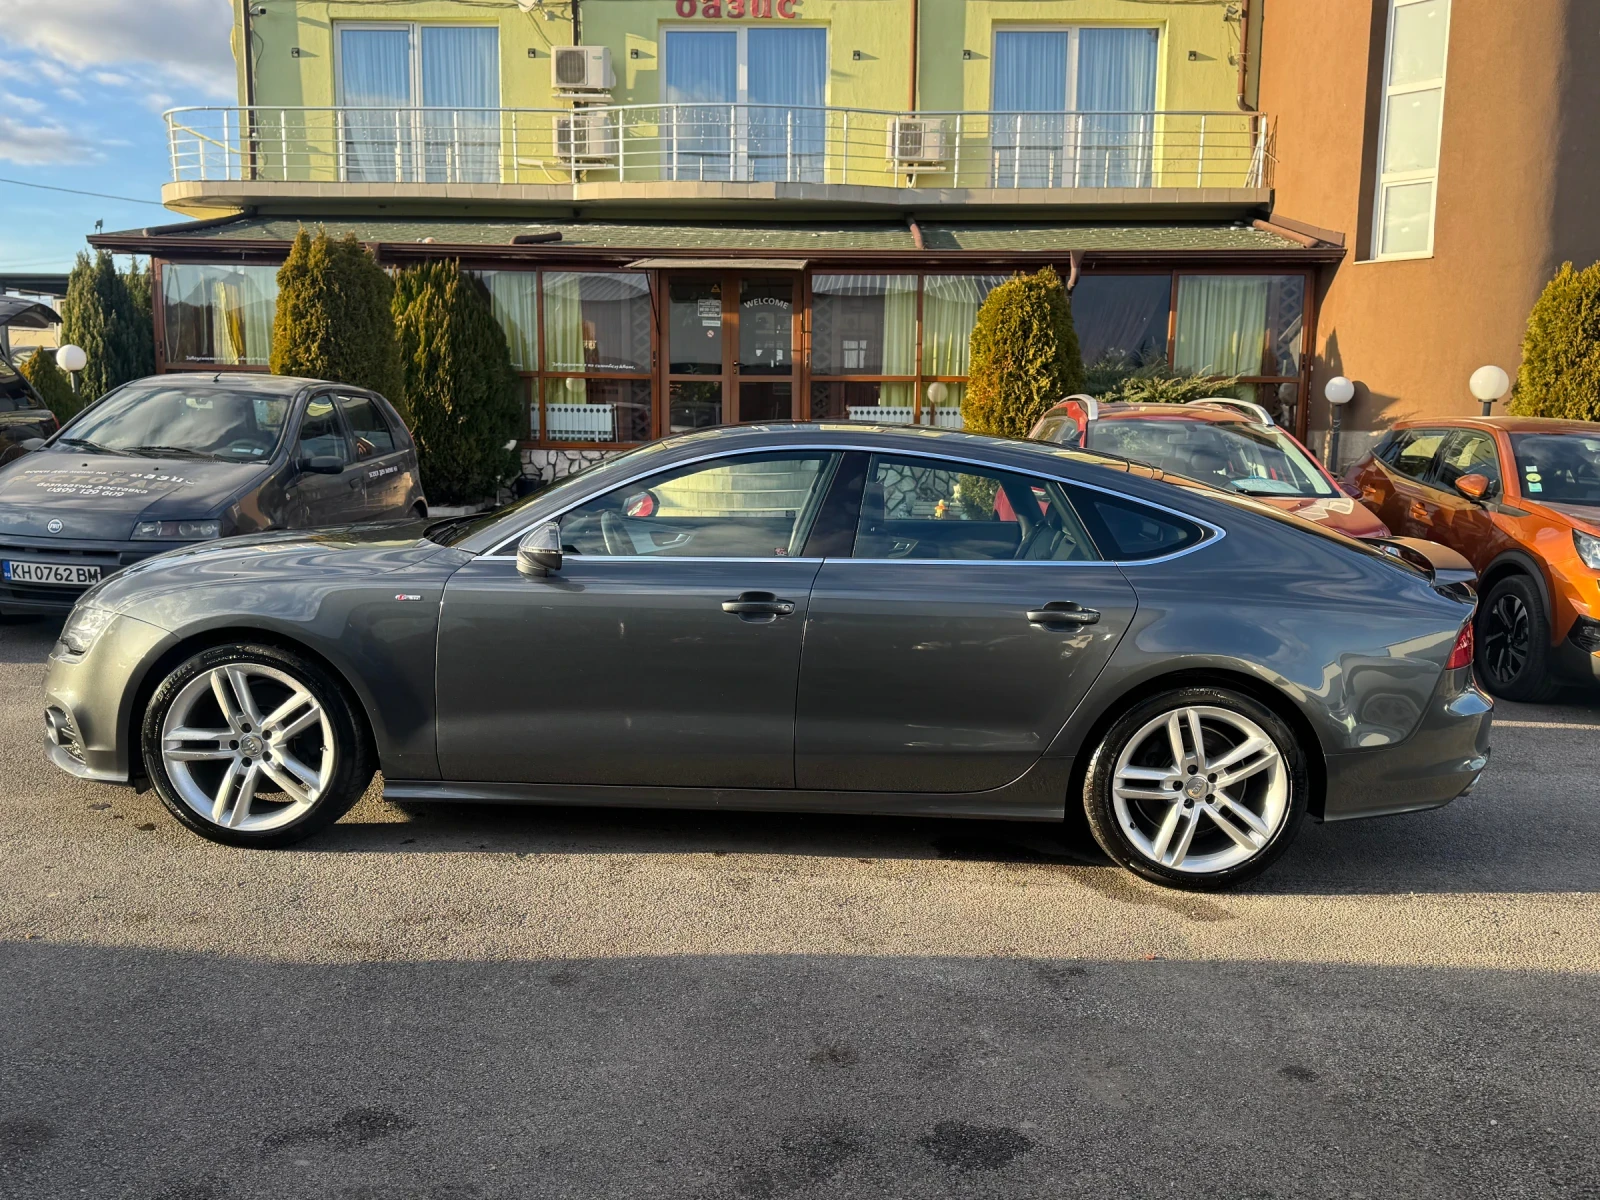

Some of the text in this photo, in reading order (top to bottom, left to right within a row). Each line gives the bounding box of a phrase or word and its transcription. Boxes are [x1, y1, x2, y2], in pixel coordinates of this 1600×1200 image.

[744, 298, 789, 309] WELCOME
[94, 485, 148, 494] доставка
[11, 563, 99, 583] KH 0762 BM
